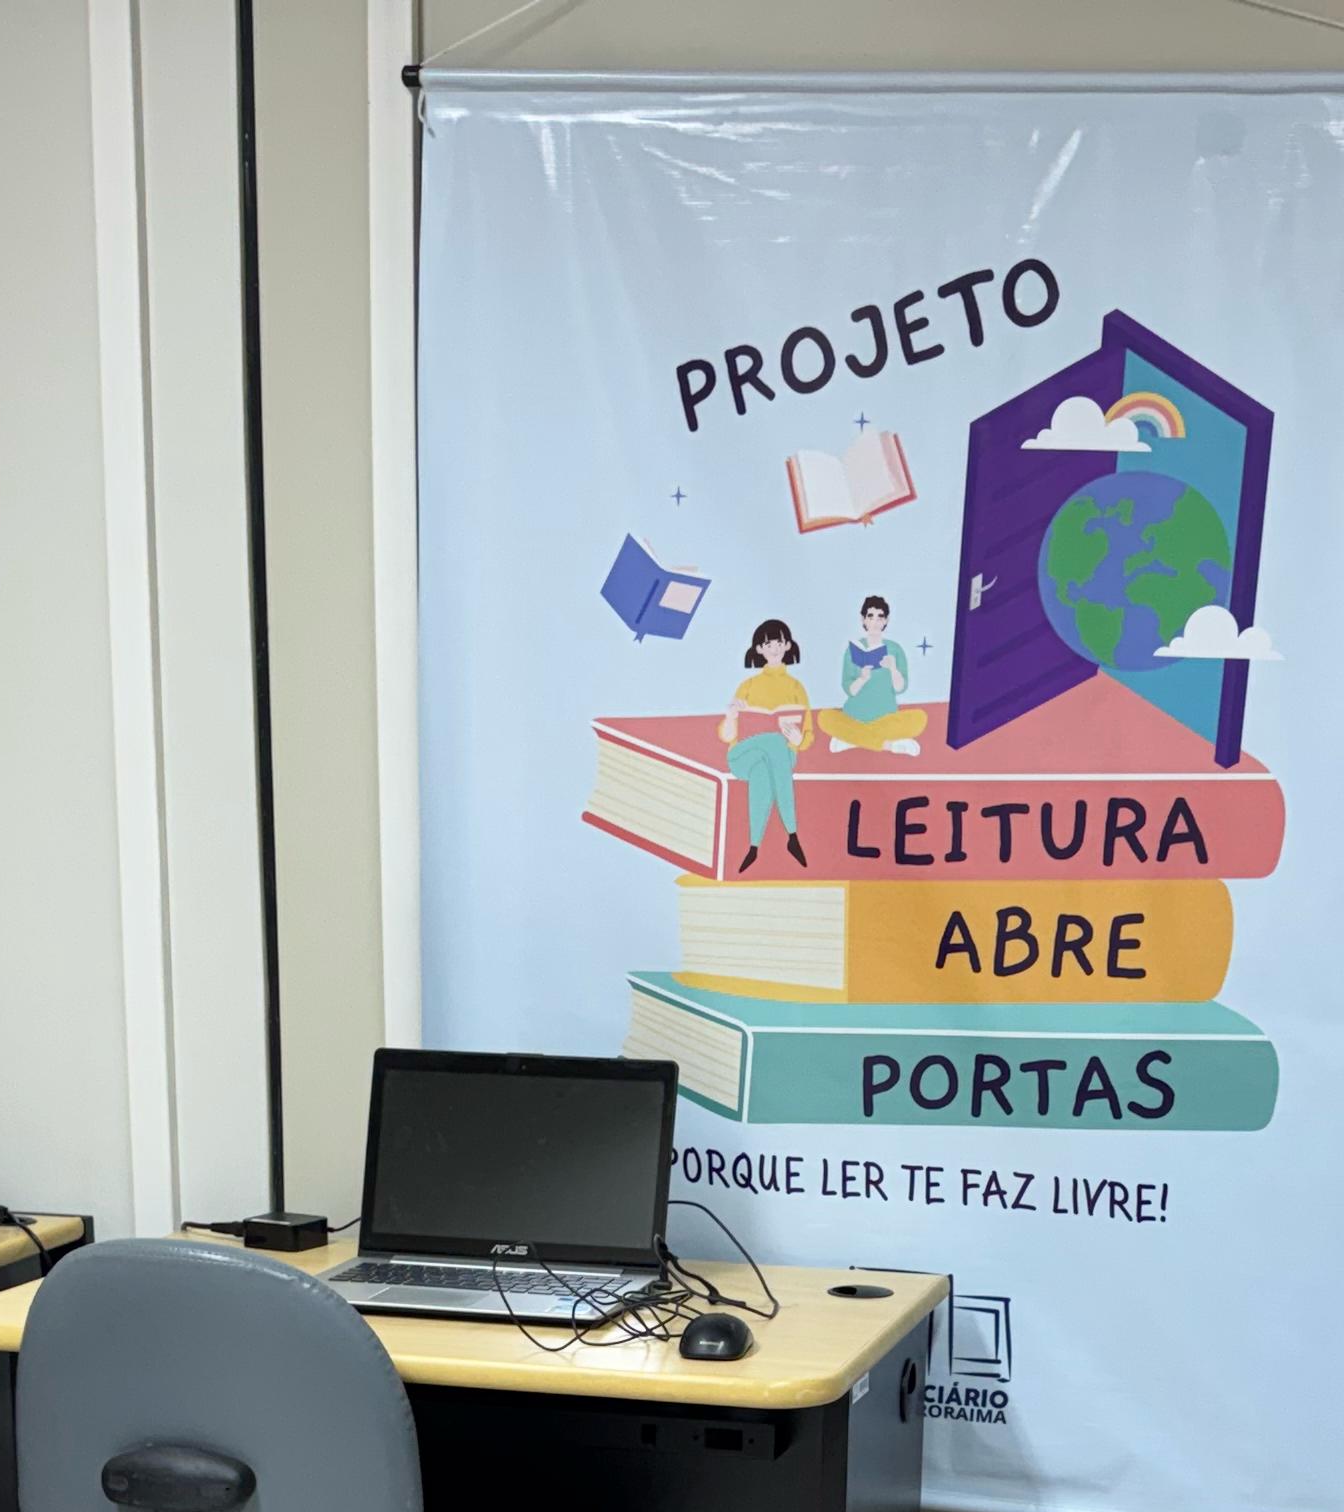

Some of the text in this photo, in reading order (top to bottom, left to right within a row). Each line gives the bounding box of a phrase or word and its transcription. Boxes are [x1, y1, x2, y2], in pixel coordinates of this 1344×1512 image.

[676, 258, 1060, 432] PROJETO
[847, 796, 1209, 867] LEITURA
[935, 906, 1147, 979] ABRE
[862, 1050, 1176, 1120] PORTAS
[821, 1158, 888, 1202] LER
[901, 1164, 945, 1205] TE
[960, 1171, 1037, 1211] FAZ
[1052, 1178, 1169, 1224] LIVRE!
[923, 1381, 1009, 1409] CIÁRIO
